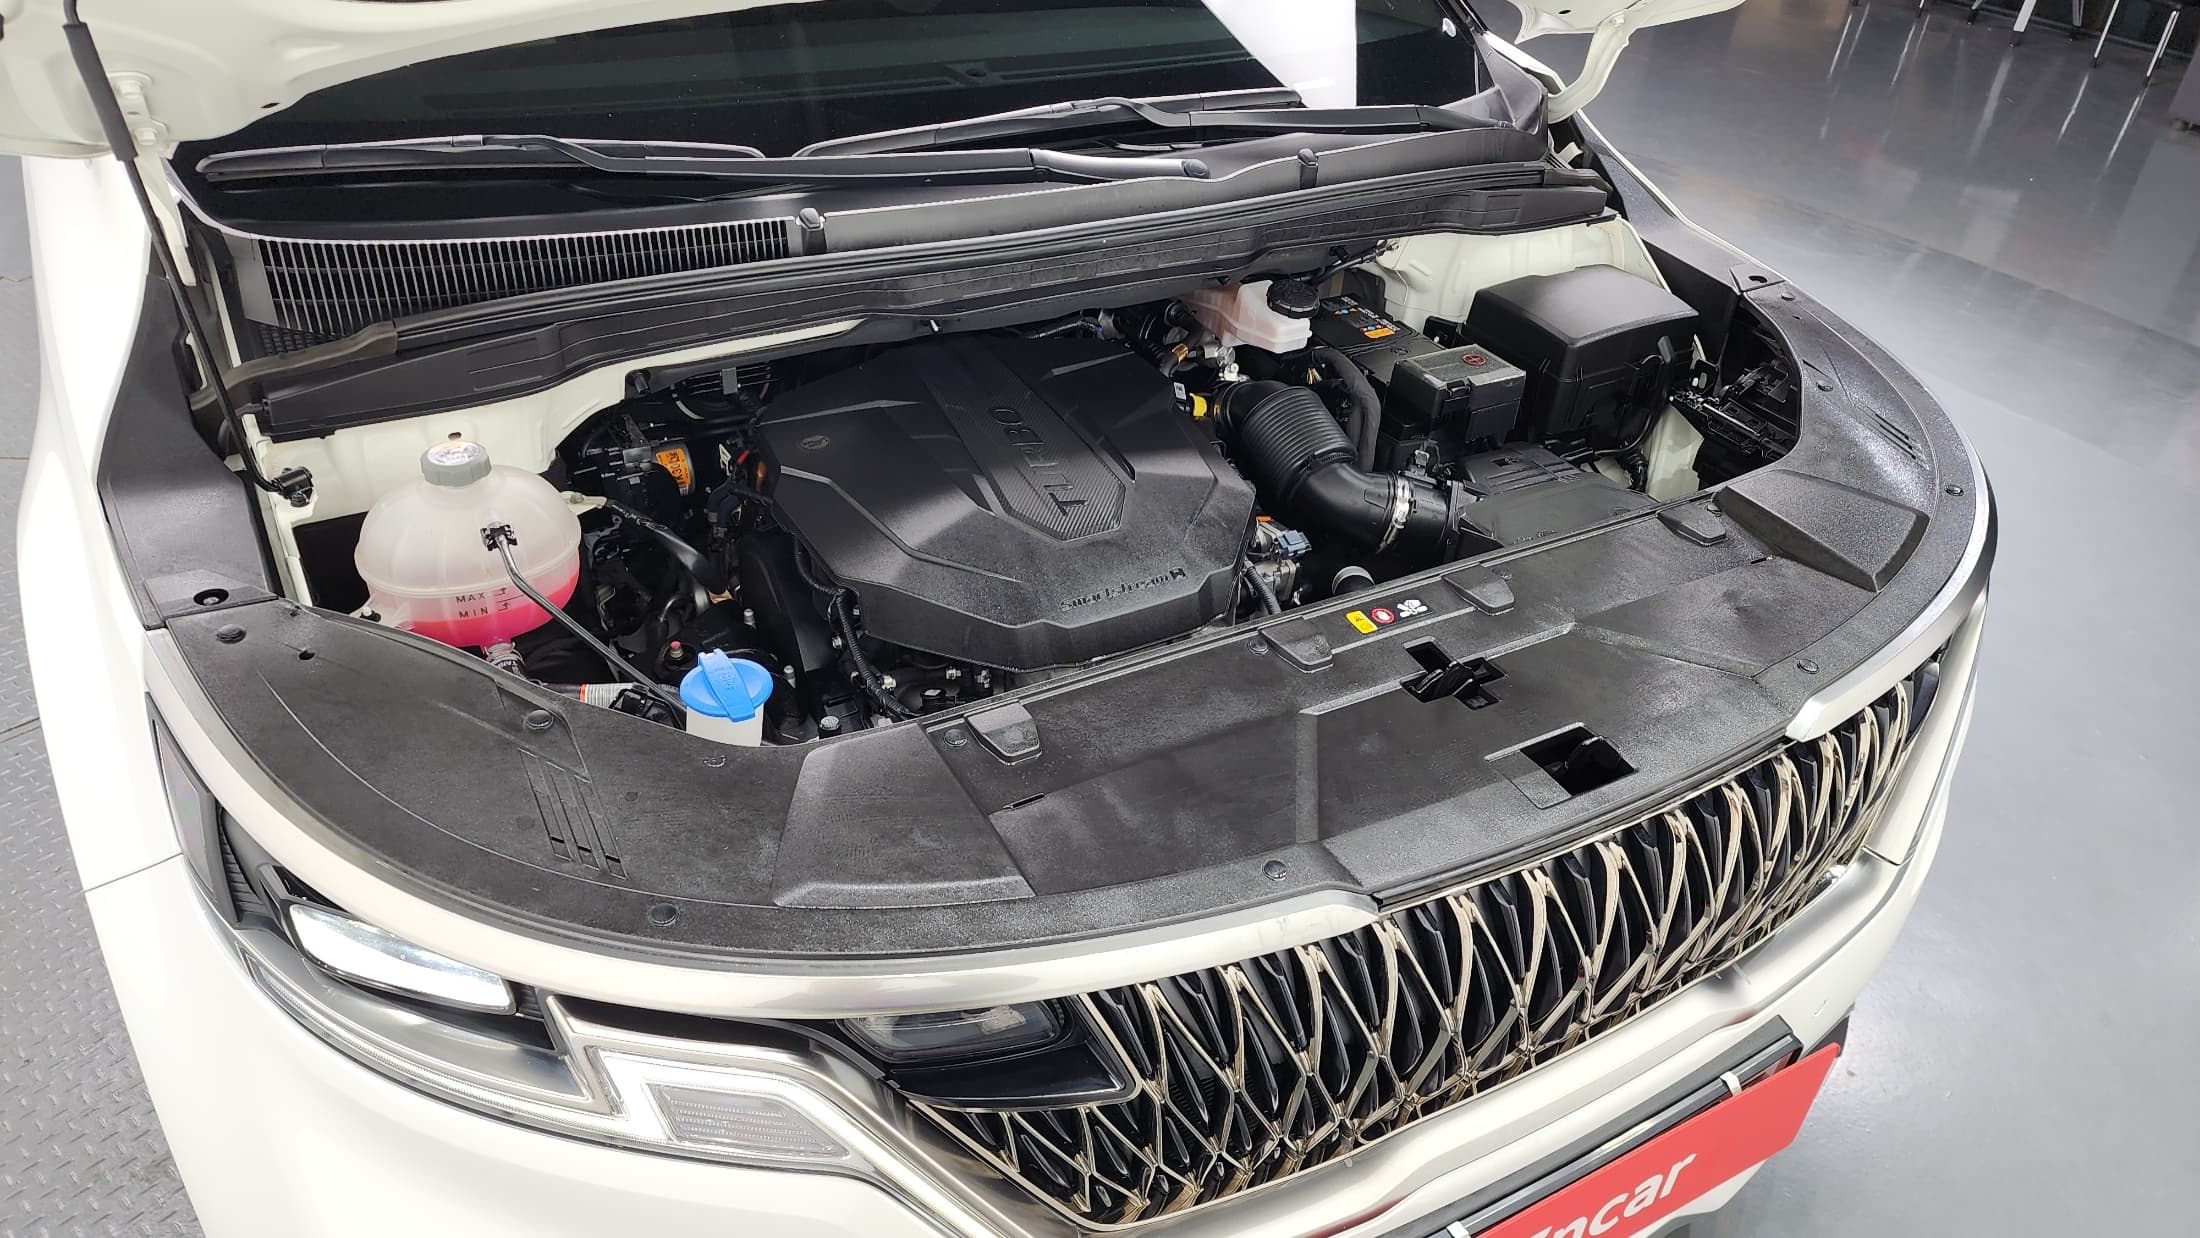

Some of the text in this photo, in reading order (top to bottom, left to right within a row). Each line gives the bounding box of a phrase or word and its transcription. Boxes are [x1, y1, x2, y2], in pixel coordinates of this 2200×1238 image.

[991, 407, 1088, 517] TURBO
[456, 592, 486, 604] MAX
[458, 607, 489, 619] MIN
